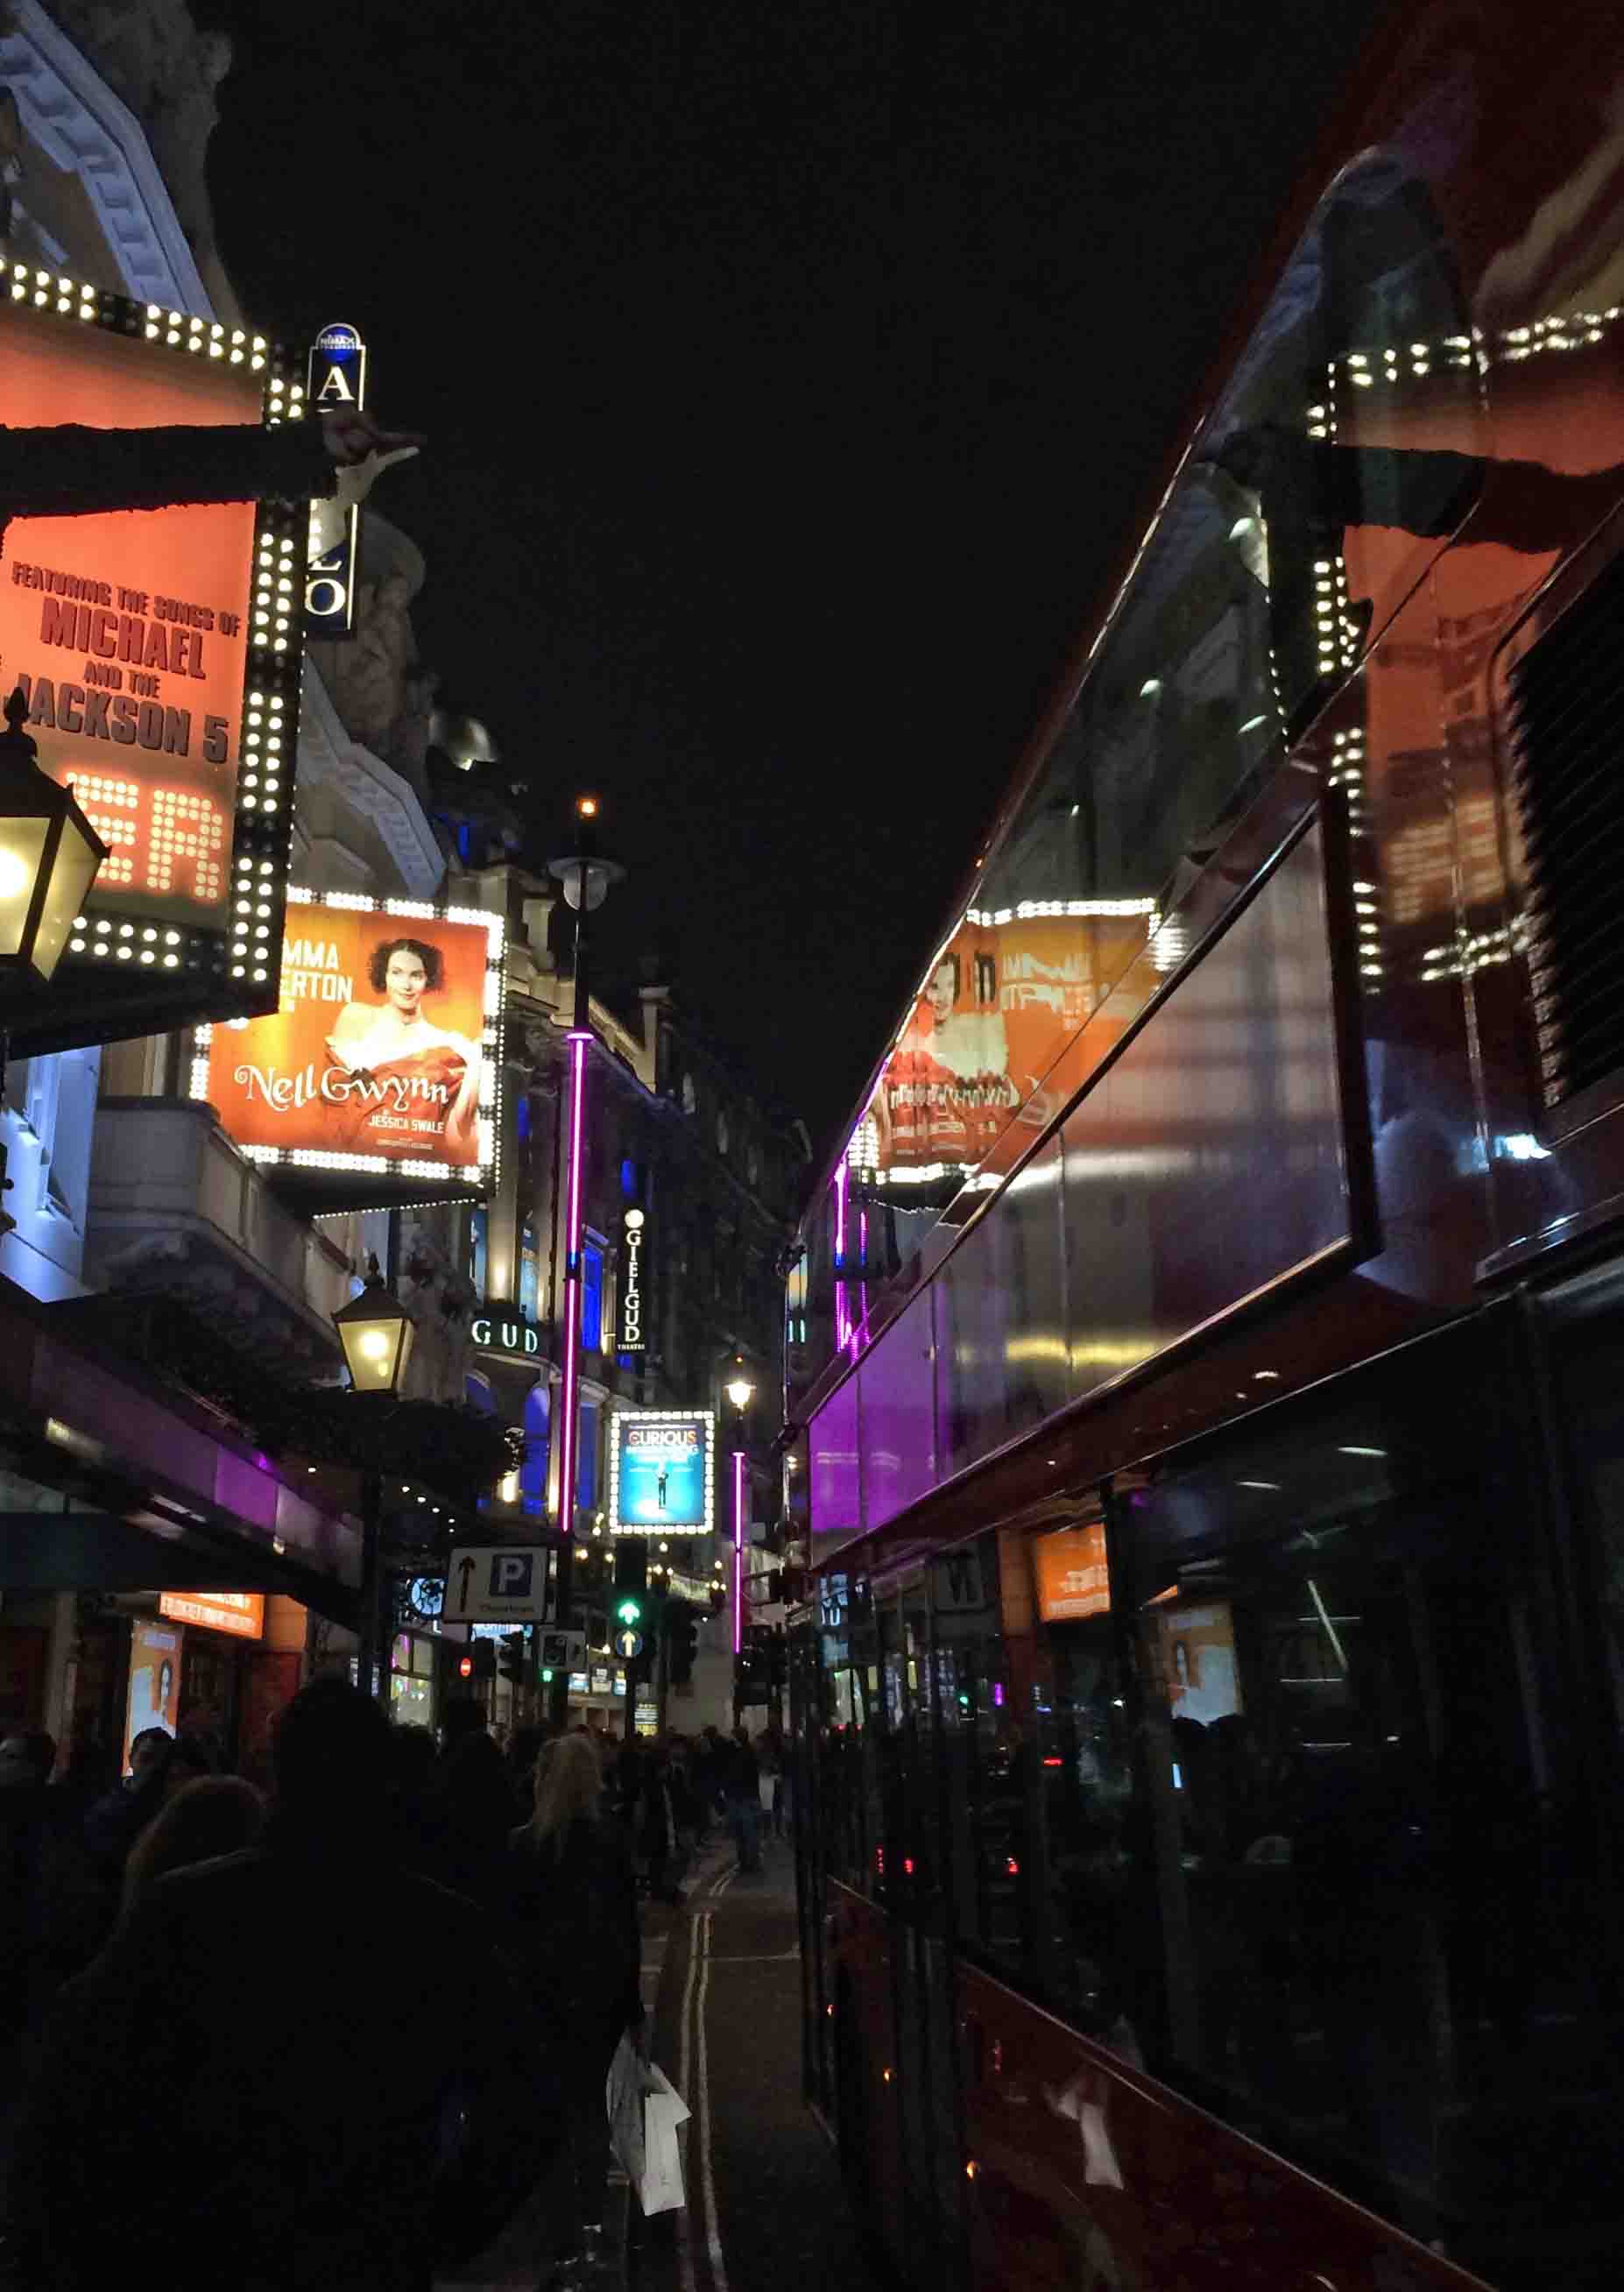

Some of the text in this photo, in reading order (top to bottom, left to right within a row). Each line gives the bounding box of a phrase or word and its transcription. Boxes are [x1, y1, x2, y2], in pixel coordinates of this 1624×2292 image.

[11, 561, 241, 638] FEATURING THE SONGS OF
[39, 597, 207, 681] MICHAEL
[84, 660, 161, 699] AND THE
[202, 714, 229, 765] 5
[234, 1064, 449, 1113] Nell Gwynn
[410, 1119, 445, 1135] SWALE
[624, 1228, 642, 1342] GIELGUD
[628, 1430, 698, 1446] CURIOUS
[498, 1557, 526, 1593] P
